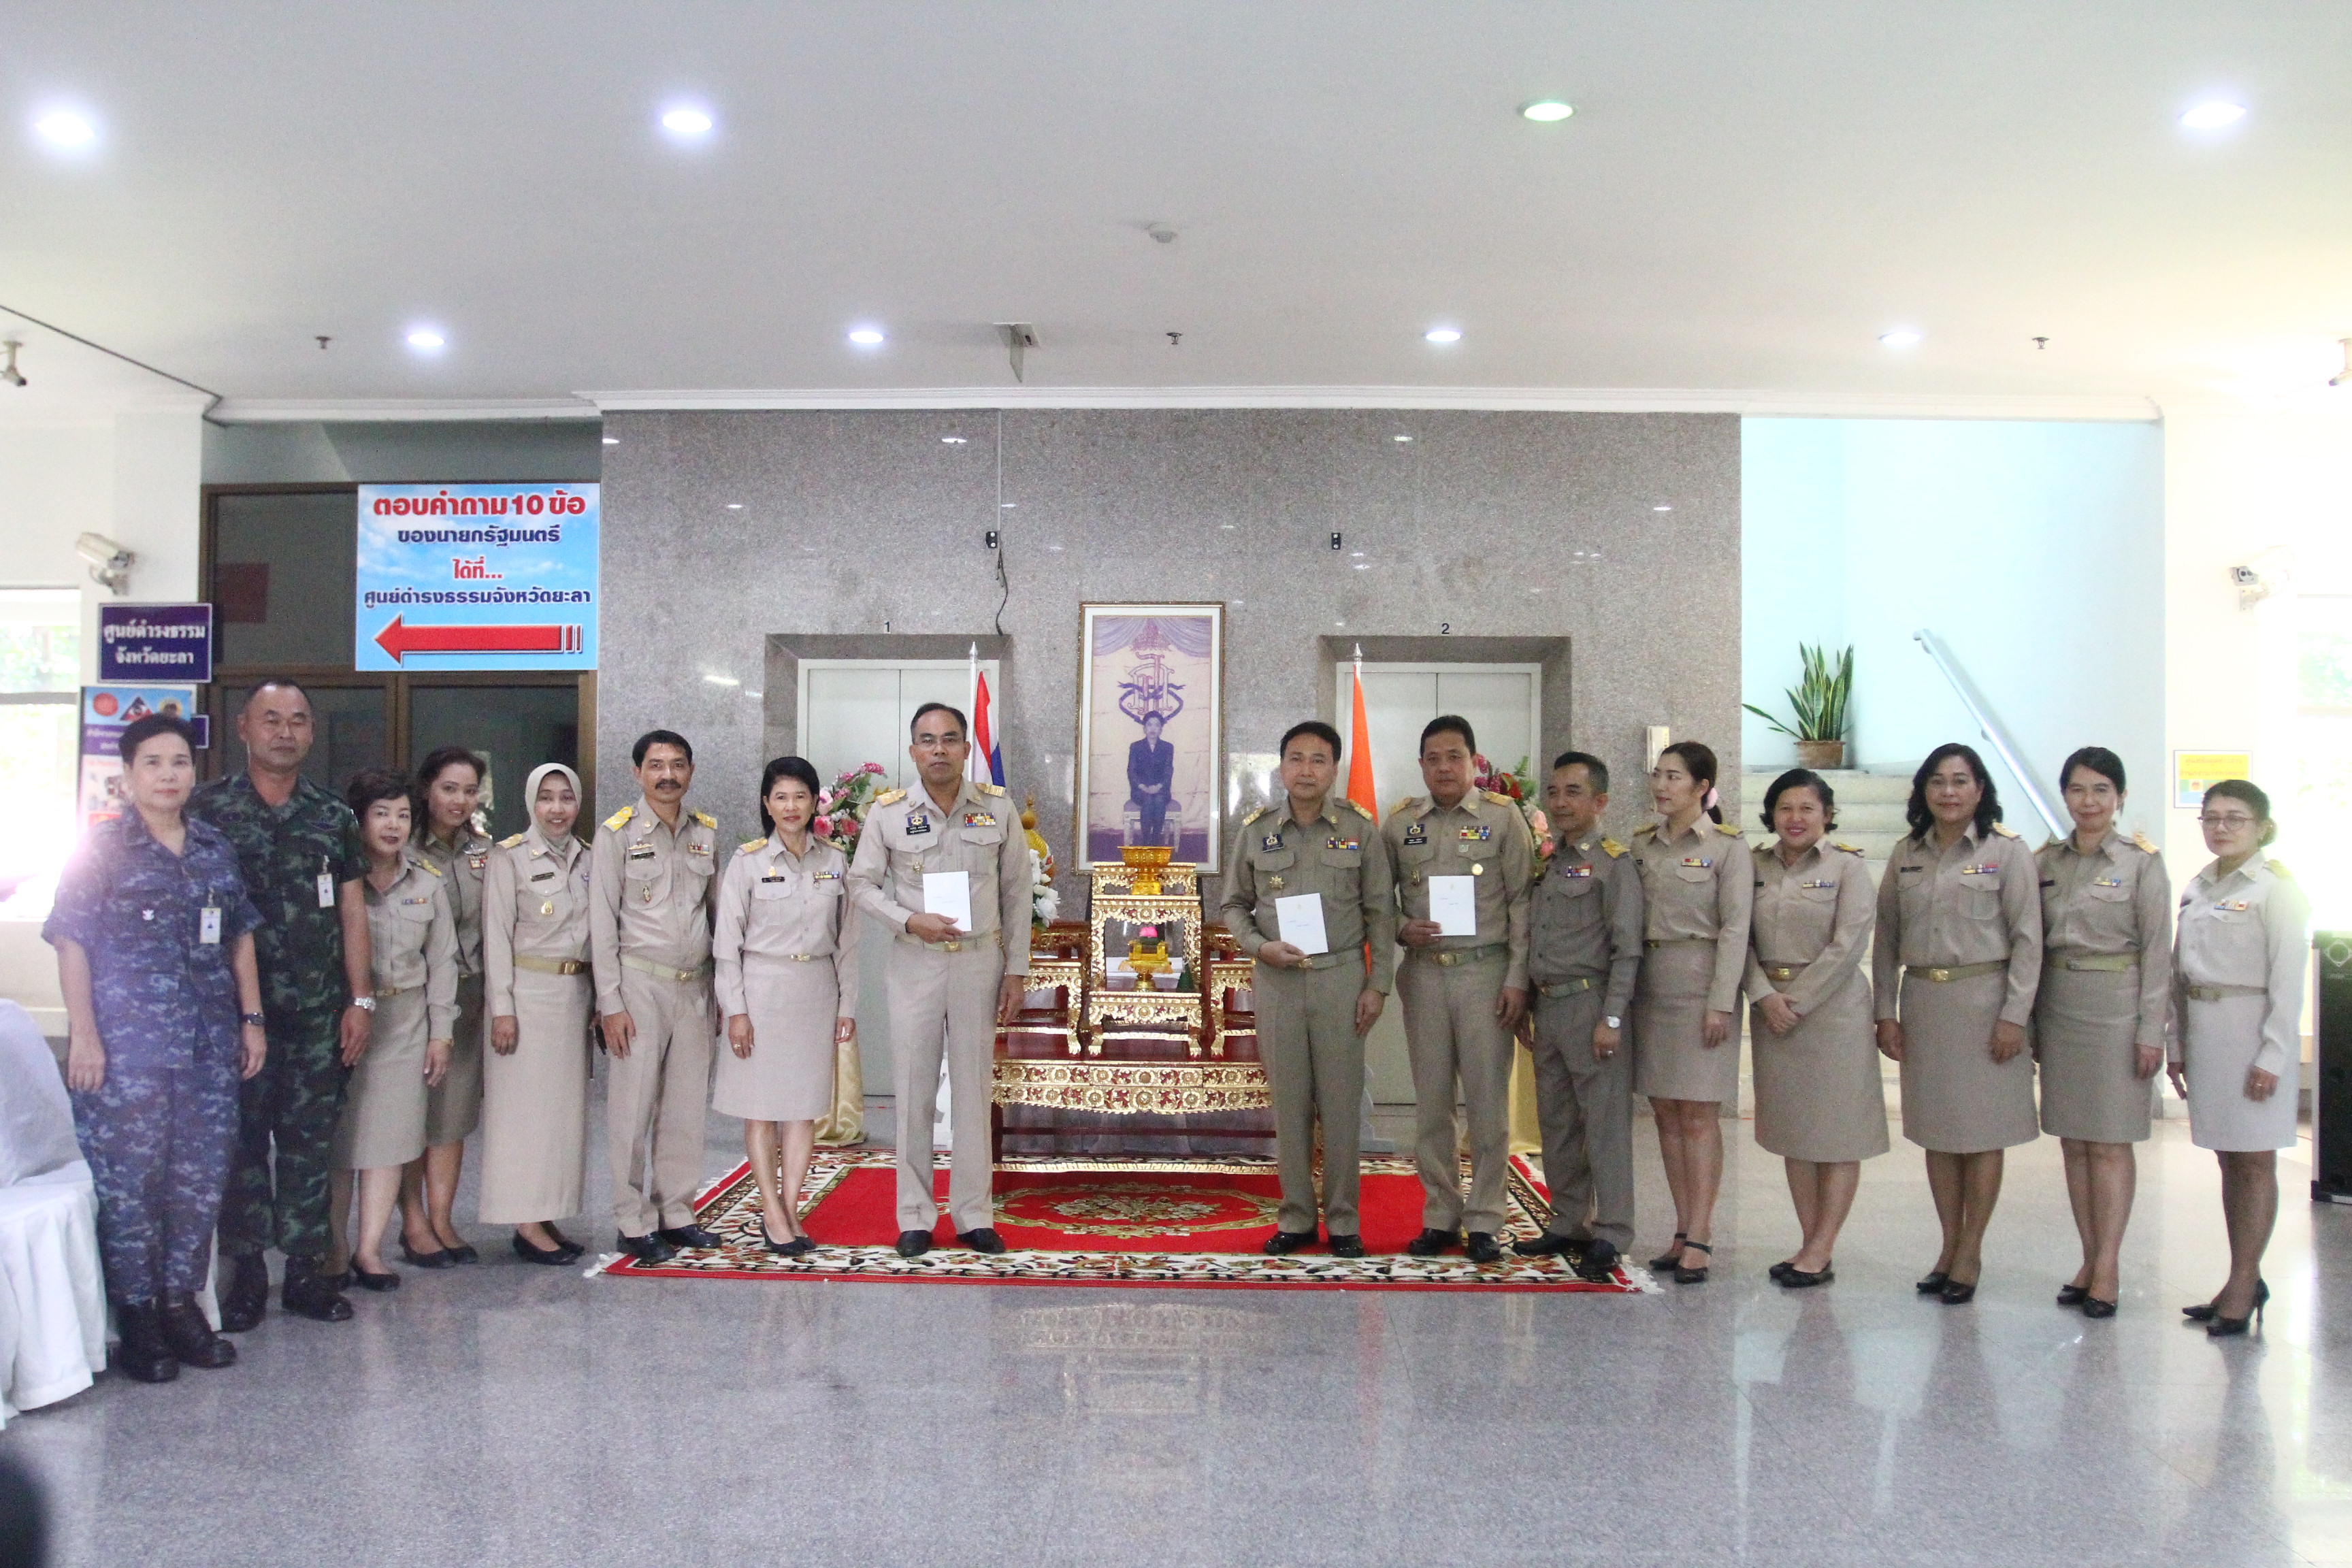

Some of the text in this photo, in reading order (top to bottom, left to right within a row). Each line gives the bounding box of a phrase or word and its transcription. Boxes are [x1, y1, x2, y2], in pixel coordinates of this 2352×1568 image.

[374, 490, 586, 515] ตอบคำถาม 10 ข้อ
[398, 524, 560, 546] ของนายกรัฐมนตรี
[453, 556, 503, 578] ได้ที่...
[364, 586, 591, 608] ศูนย์ดำรงธรรมจังหวัดยะลา
[103, 618, 206, 644] ศูนย์ดำรงธรรม
[884, 621, 890, 633] 1
[1441, 622, 1450, 635] 2
[115, 646, 195, 664] จังหวัดยะลา
